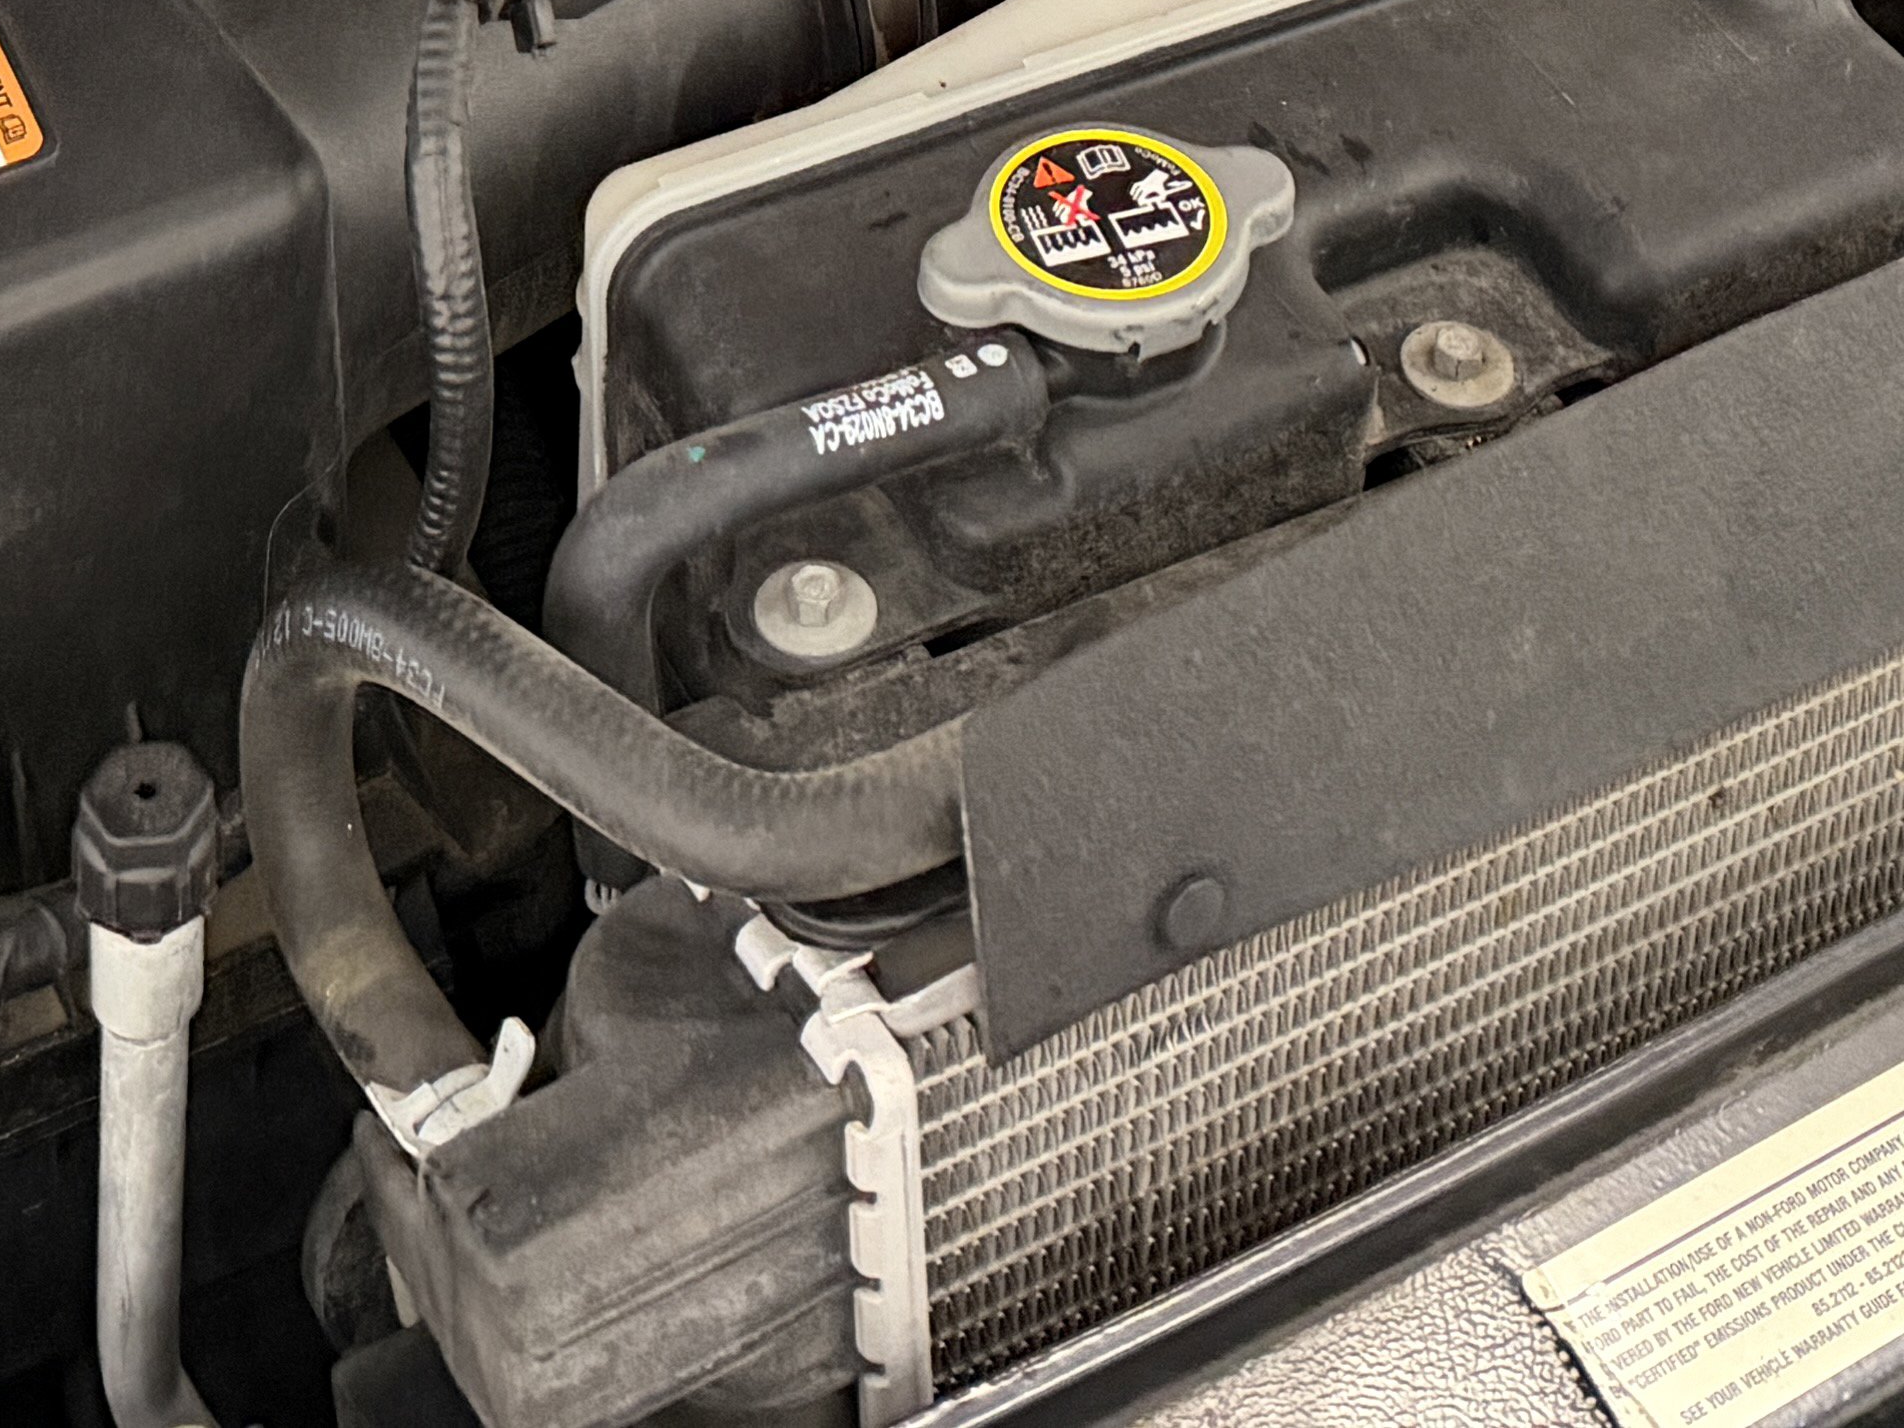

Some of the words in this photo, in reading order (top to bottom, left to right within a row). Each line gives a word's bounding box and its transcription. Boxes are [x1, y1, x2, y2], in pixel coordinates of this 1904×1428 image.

[1178, 197, 1206, 213] OK
[1619, 1306, 1655, 1334] PART
[1653, 1295, 1674, 1315] TO
[1671, 1277, 1707, 1307] FAIL,
[1703, 1263, 1731, 1286] THE
[1728, 1244, 1765, 1272] COST
[1761, 1233, 1783, 1253] OF
[1780, 1219, 1808, 1242] THE
[1804, 1194, 1852, 1228] REPAIR
[1847, 1179, 1878, 1203] AND
[1874, 1164, 1903, 1188] ANY
[1713, 1230, 1735, 1250] OF
[1731, 1224, 1747, 1240] A
[1743, 1189, 1808, 1233] NON-FORD
[1804, 1165, 1850, 1199] MOTOR
[1606, 1337, 1655, 1374] VERED
[1652, 1327, 1674, 1347] BY
[1671, 1311, 1700, 1336] THE
[1696, 1291, 1735, 1321] FORD
[1731, 1275, 1764, 1301] NEW
[1760, 1246, 1814, 1284] VEHICLE
[1809, 1217, 1863, 1256] LIMITED
[1628, 1340, 1705, 1393] "CERTIFIED"
[1702, 1300, 1773, 1349] EMISSIONS
[1769, 1268, 1828, 1310] PRODUCT
[1825, 1243, 1870, 1277] UNDER
[1866, 1229, 1895, 1253] THE
[1679, 1400, 1708, 1426] SEE
[1705, 1380, 1742, 1410] YOUR
[1739, 1350, 1794, 1390] VEHICLE
[1790, 1310, 1861, 1359] WARRANTY
[1857, 1288, 1898, 1319] GUIDE
[1809, 1280, 1859, 1317] 85.2112
